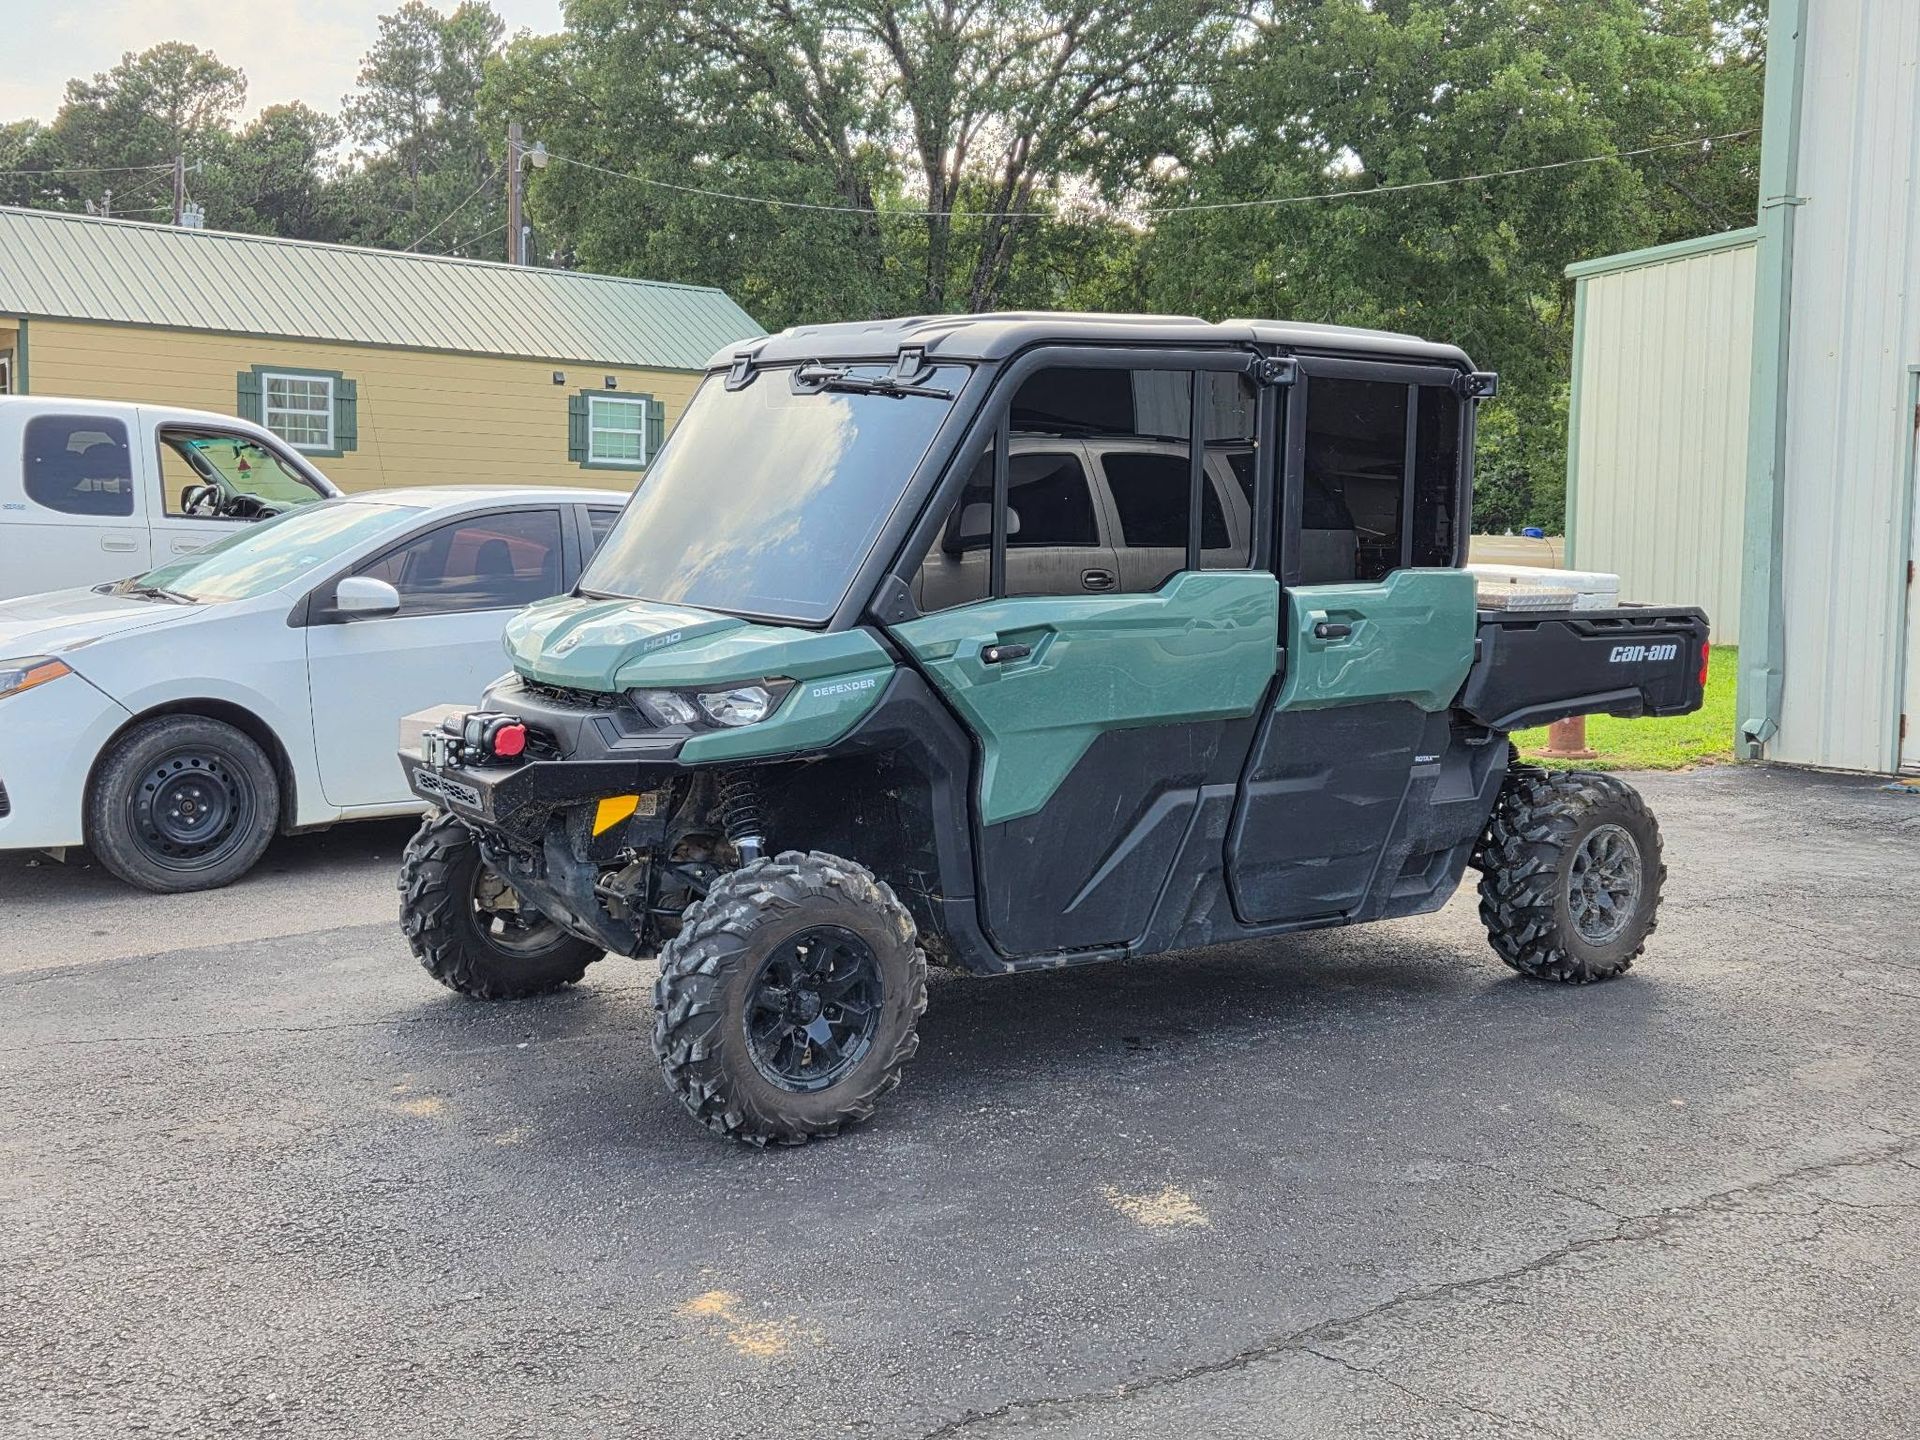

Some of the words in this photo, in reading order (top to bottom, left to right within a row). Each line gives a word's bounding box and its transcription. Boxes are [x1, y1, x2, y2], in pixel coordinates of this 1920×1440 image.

[643, 632, 682, 653] HD10
[1609, 644, 1677, 663] can-am
[812, 679, 876, 697] DEFENDER
